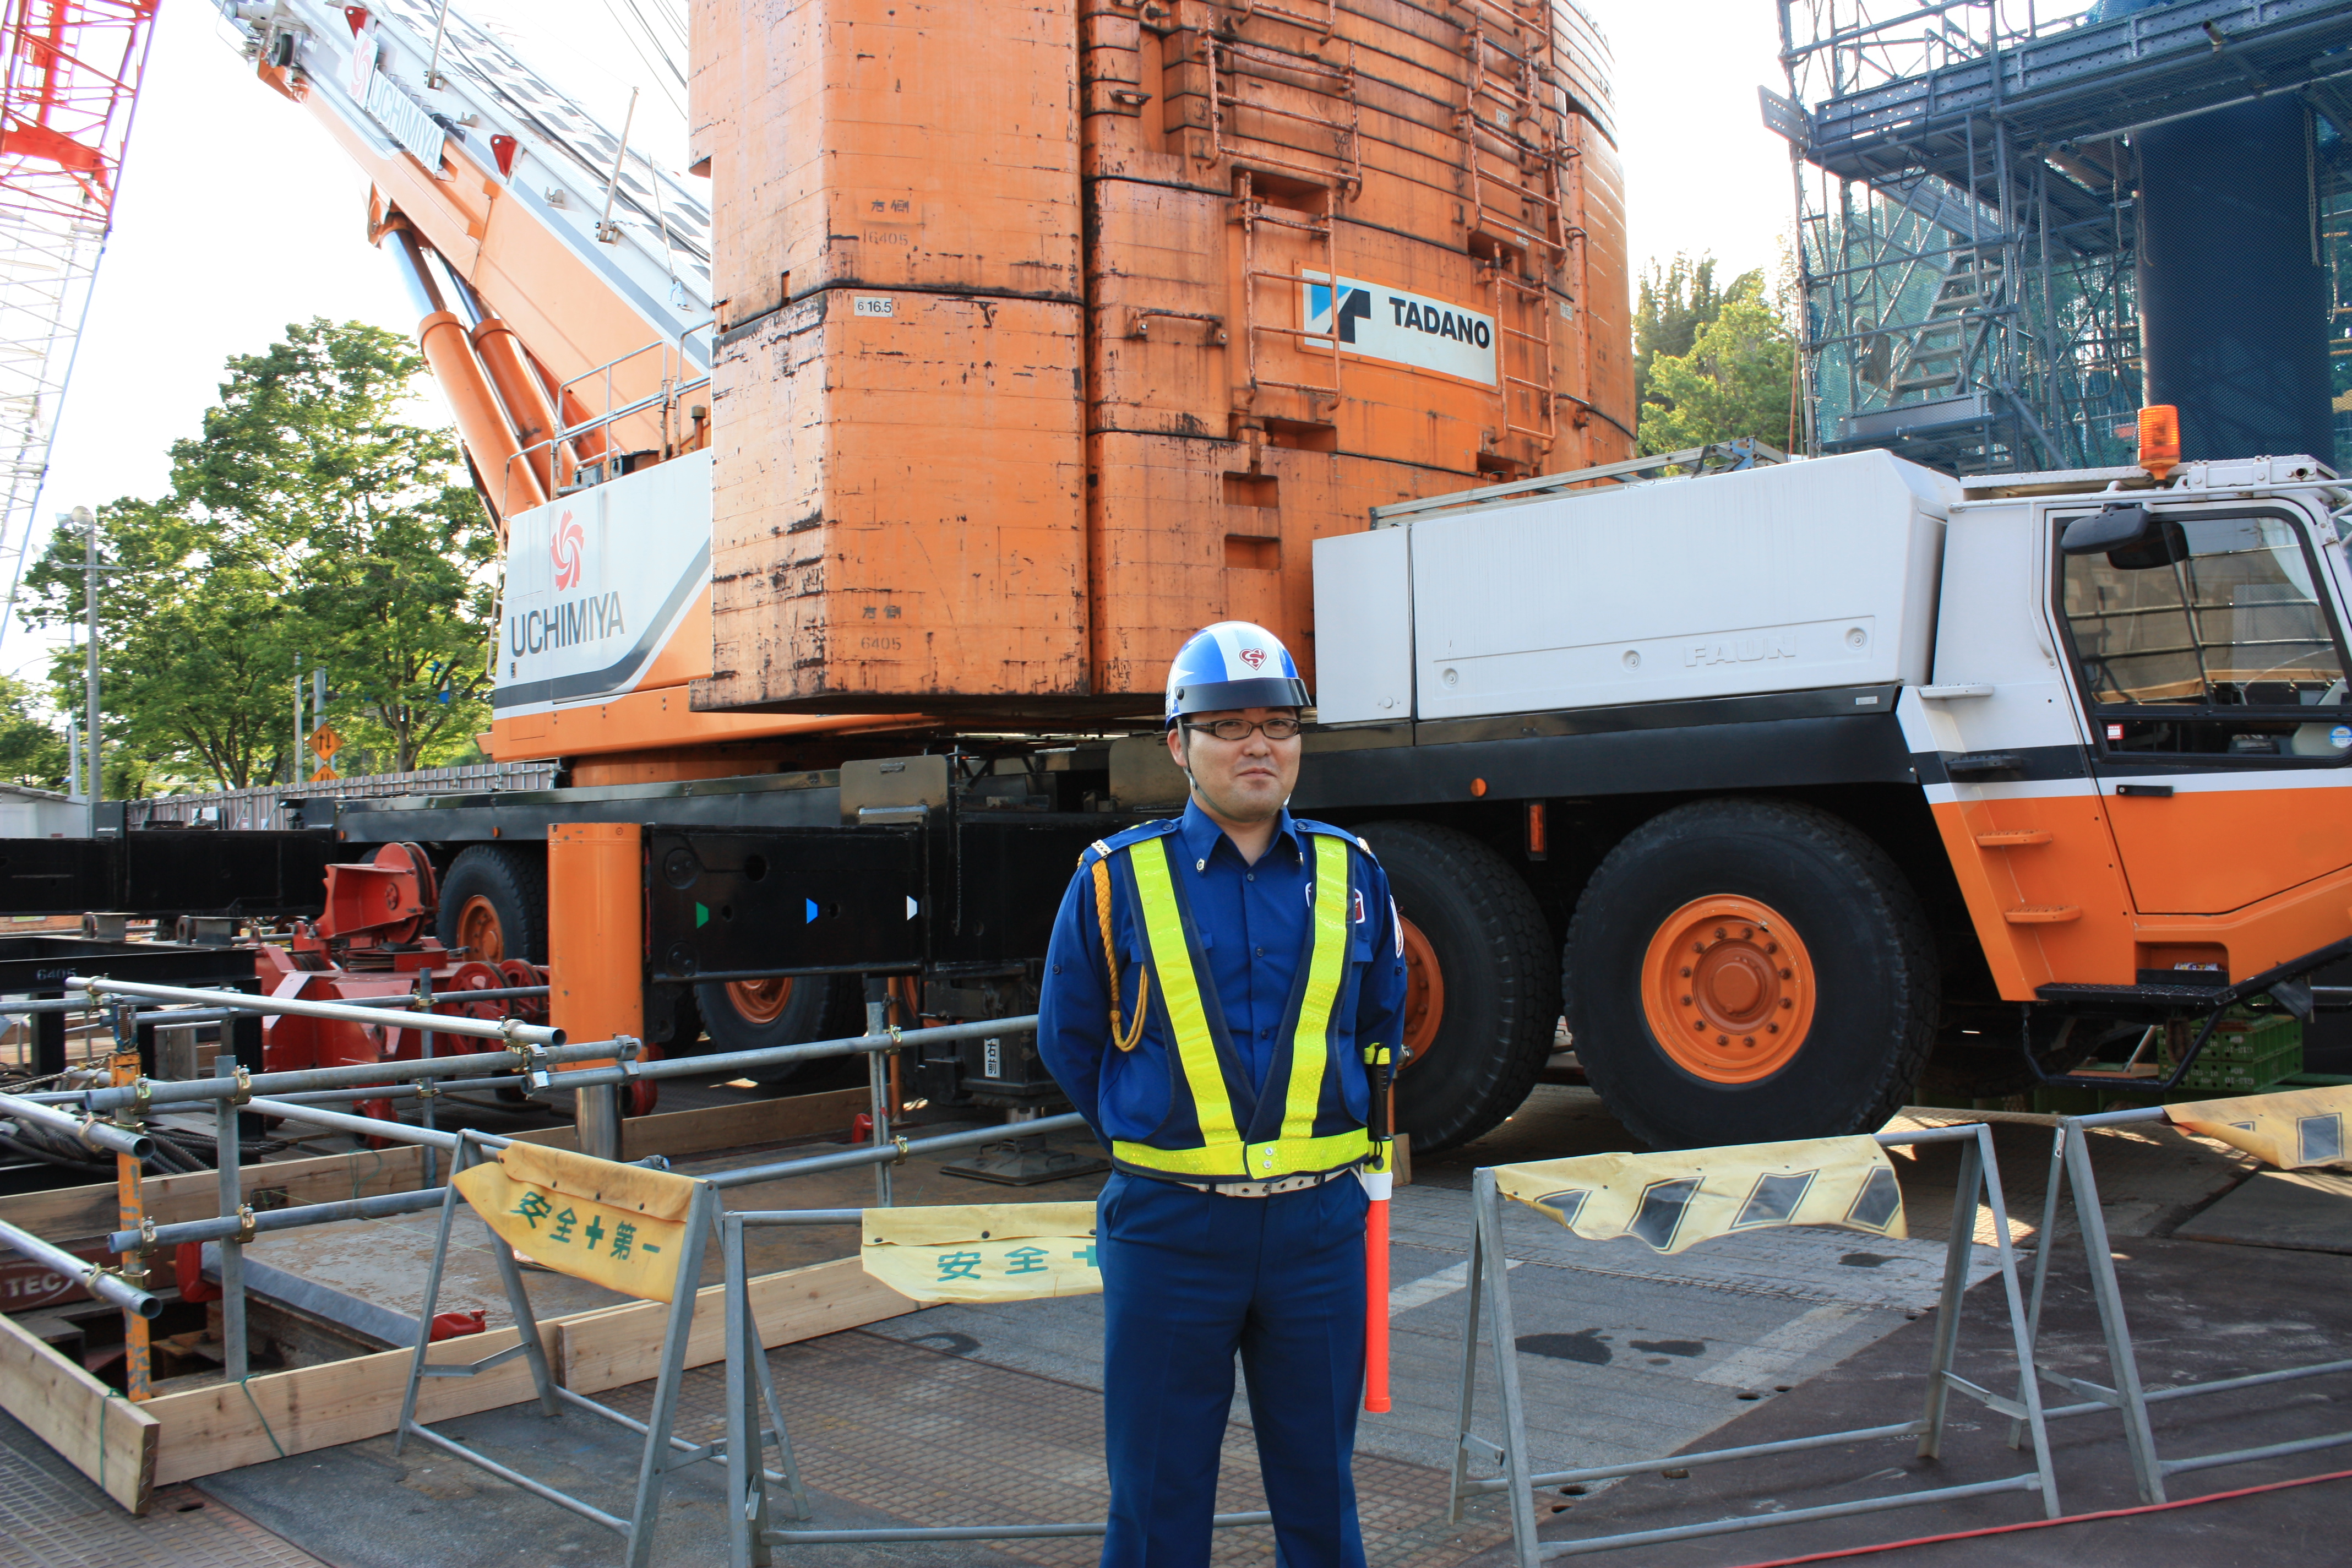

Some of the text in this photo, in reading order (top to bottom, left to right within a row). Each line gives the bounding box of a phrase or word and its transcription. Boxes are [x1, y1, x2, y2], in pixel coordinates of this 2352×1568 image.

[369, 73, 440, 169] UCHIMIYA
[871, 199, 910, 213] 右側
[1389, 296, 1490, 350] TADANO
[510, 590, 625, 657] UCHIMIYA
[862, 605, 901, 619] 右側
[861, 636, 902, 650] 6405
[1685, 634, 1796, 667] FAUN
[36, 968, 77, 981] 6405
[987, 1041, 997, 1075] 右前
